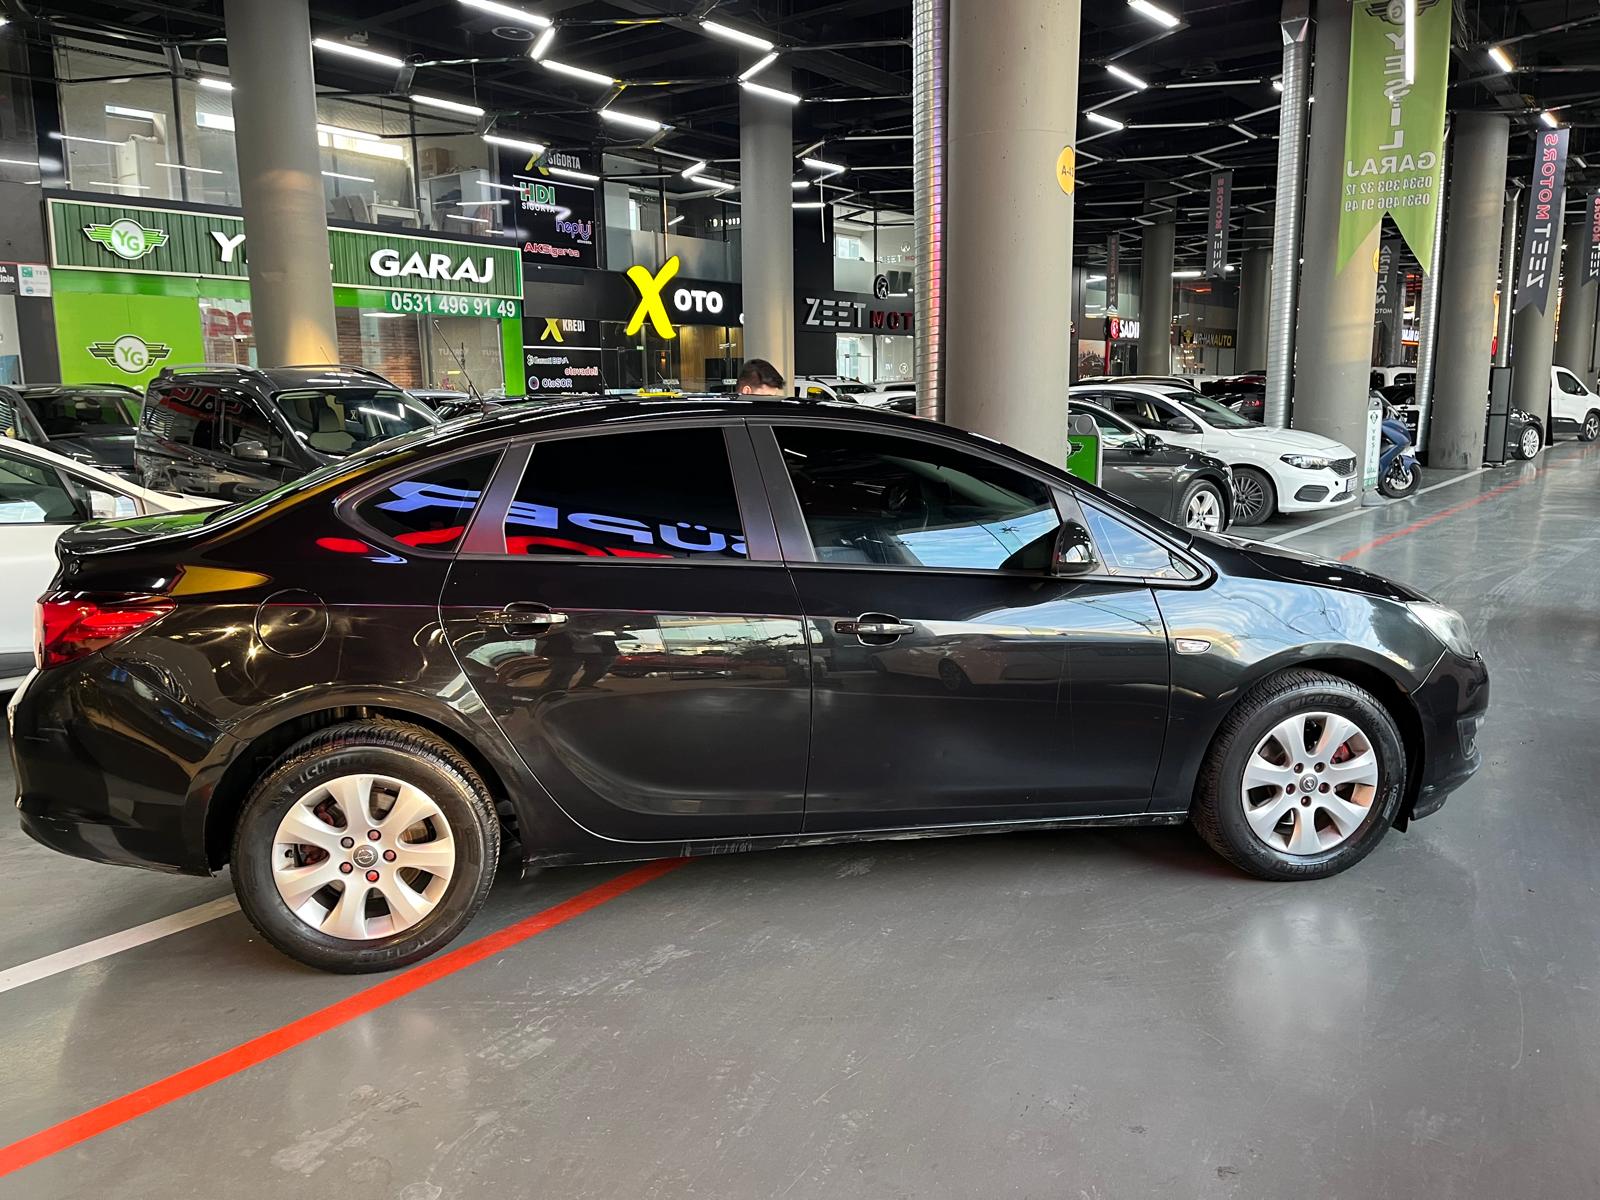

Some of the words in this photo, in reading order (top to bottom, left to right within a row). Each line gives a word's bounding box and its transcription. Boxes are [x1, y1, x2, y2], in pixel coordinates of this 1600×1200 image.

[520, 182, 556, 205] HDI
[115, 229, 140, 251] YG
[370, 249, 494, 283] GARAJ
[391, 292, 432, 312] 0531
[438, 296, 469, 315] 496
[474, 298, 492, 316] 91
[497, 300, 516, 317] 49
[626, 255, 680, 339] X
[673, 288, 723, 314] OTO
[806, 298, 866, 328] ZEET
[869, 310, 915, 330] MOT
[118, 346, 144, 365] YG
